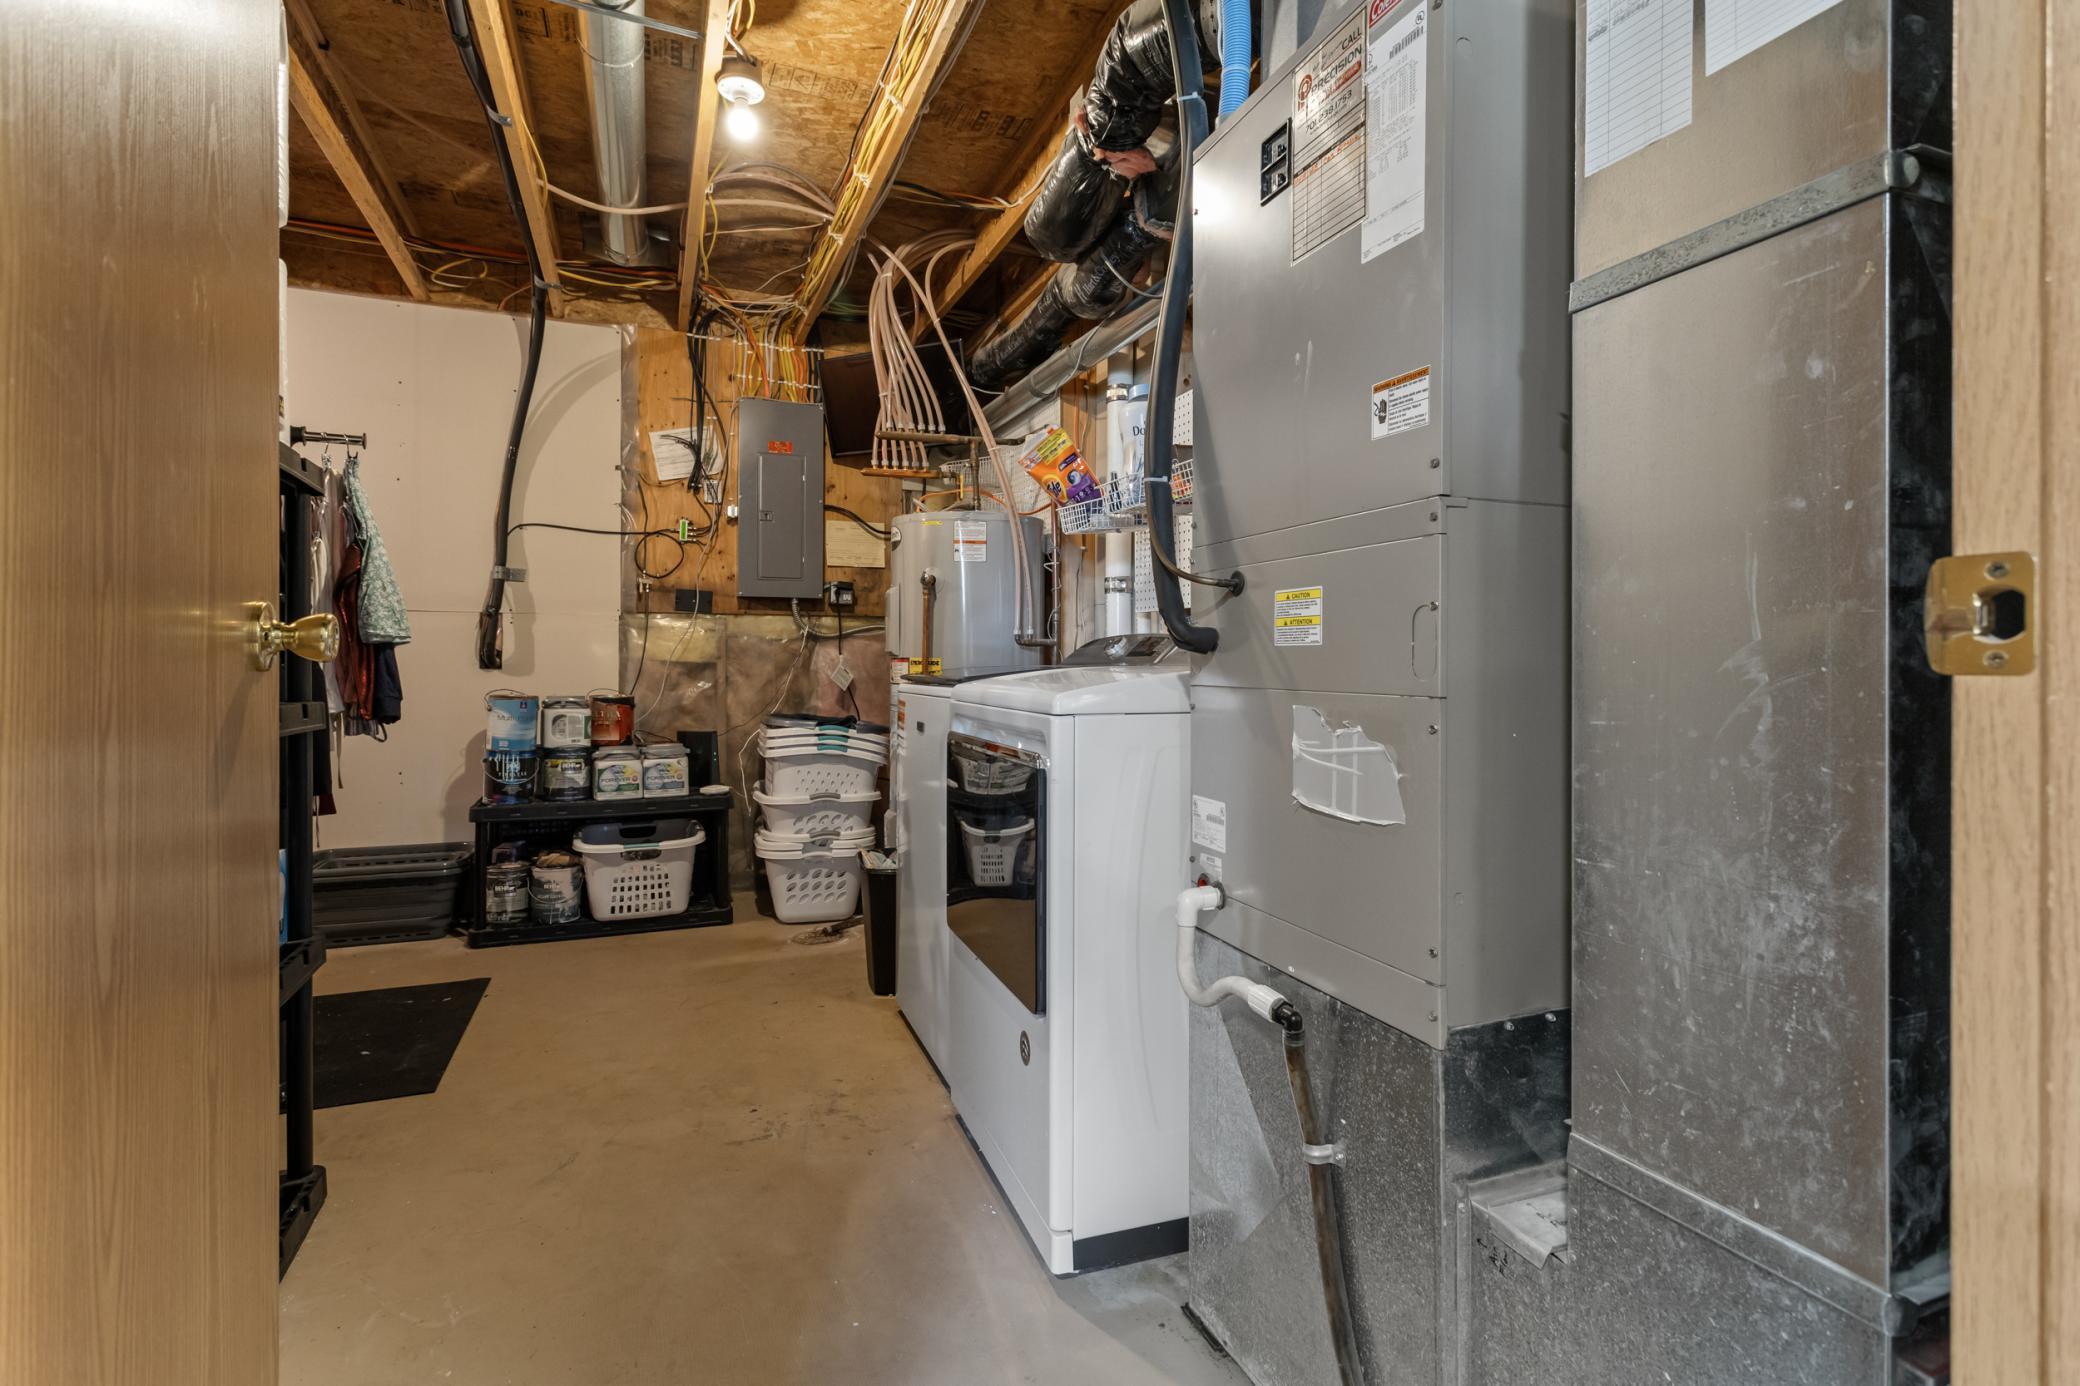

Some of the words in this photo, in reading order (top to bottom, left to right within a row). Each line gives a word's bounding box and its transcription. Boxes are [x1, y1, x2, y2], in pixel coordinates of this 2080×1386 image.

[1341, 27, 1362, 50] CALL
[1310, 44, 1362, 94] PRECISION
[1291, 592, 1311, 600] CAUTION
[1289, 618, 1313, 626] ATTENTION
